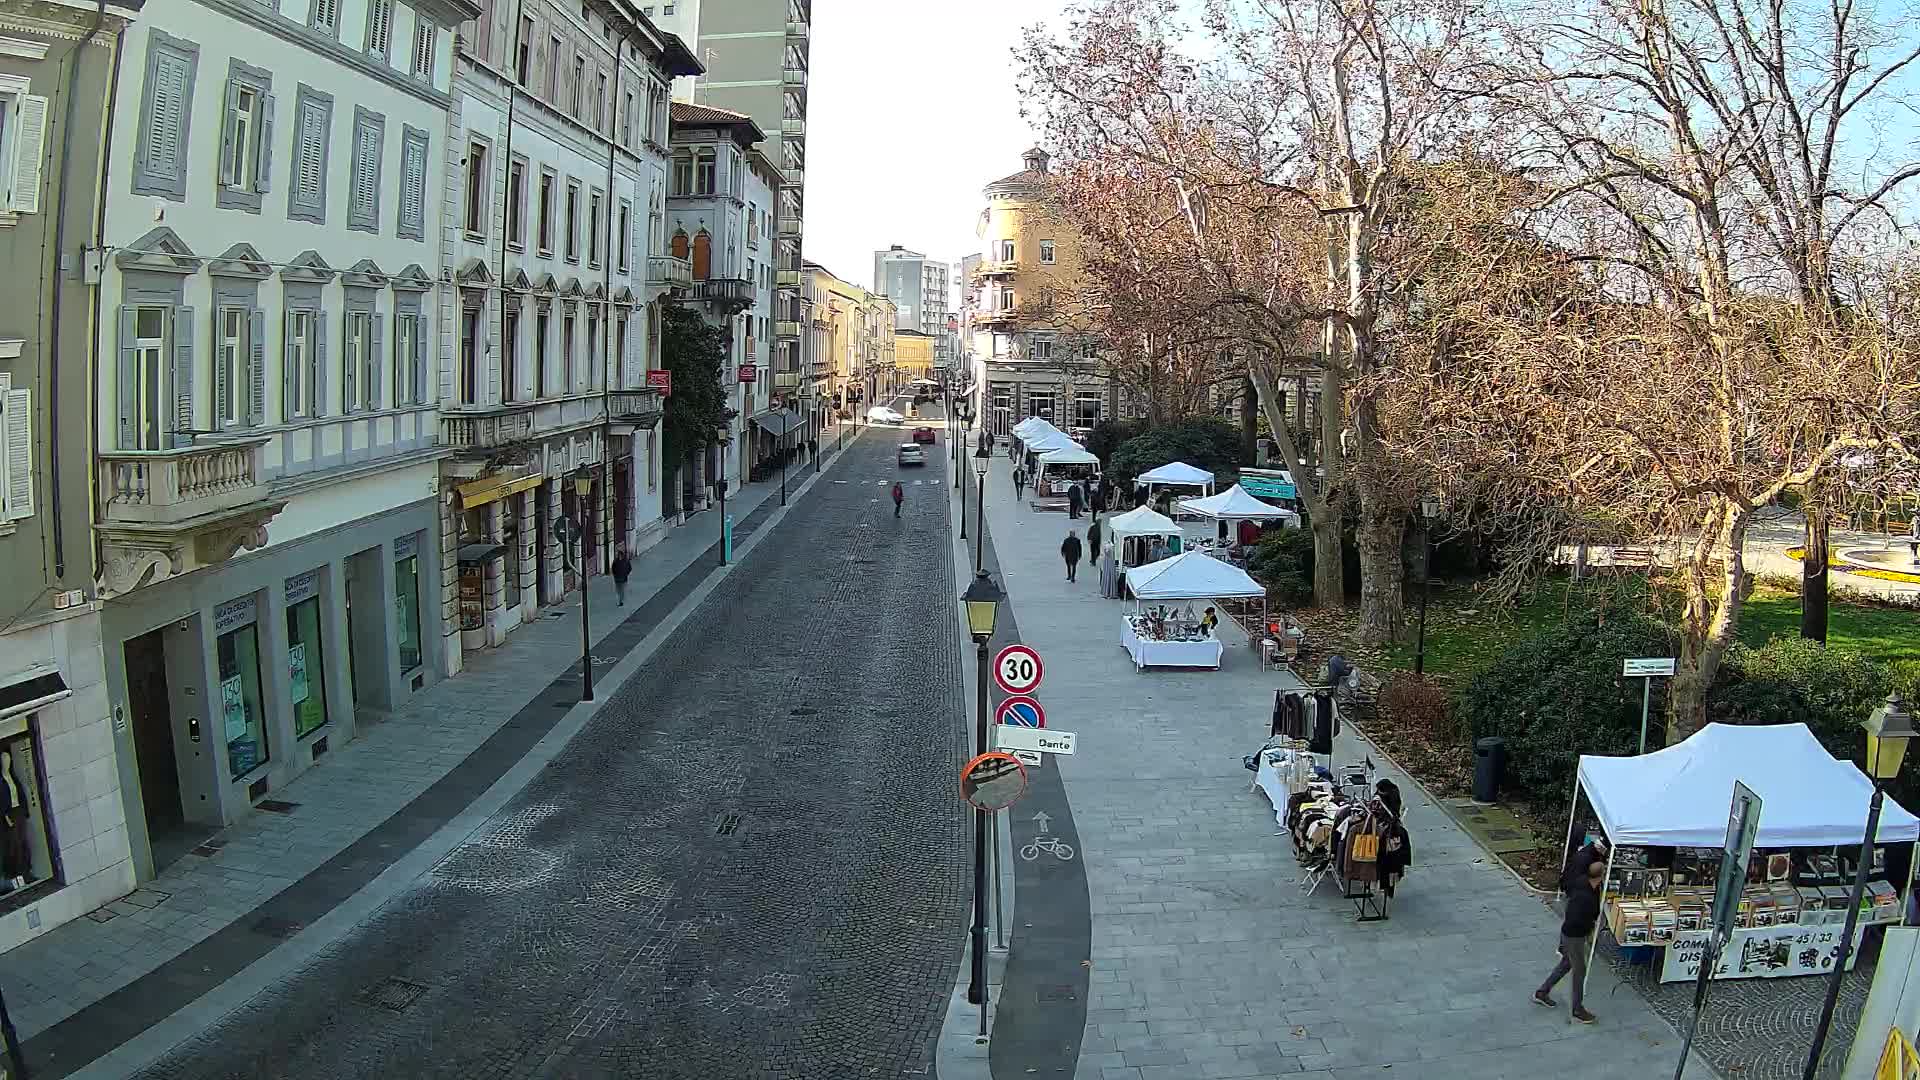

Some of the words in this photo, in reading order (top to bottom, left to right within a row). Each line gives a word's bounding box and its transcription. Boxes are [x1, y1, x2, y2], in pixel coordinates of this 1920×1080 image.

[1005, 659, 1033, 681] 30
[222, 679, 241, 701] 130
[1039, 738, 1070, 749] Dante
